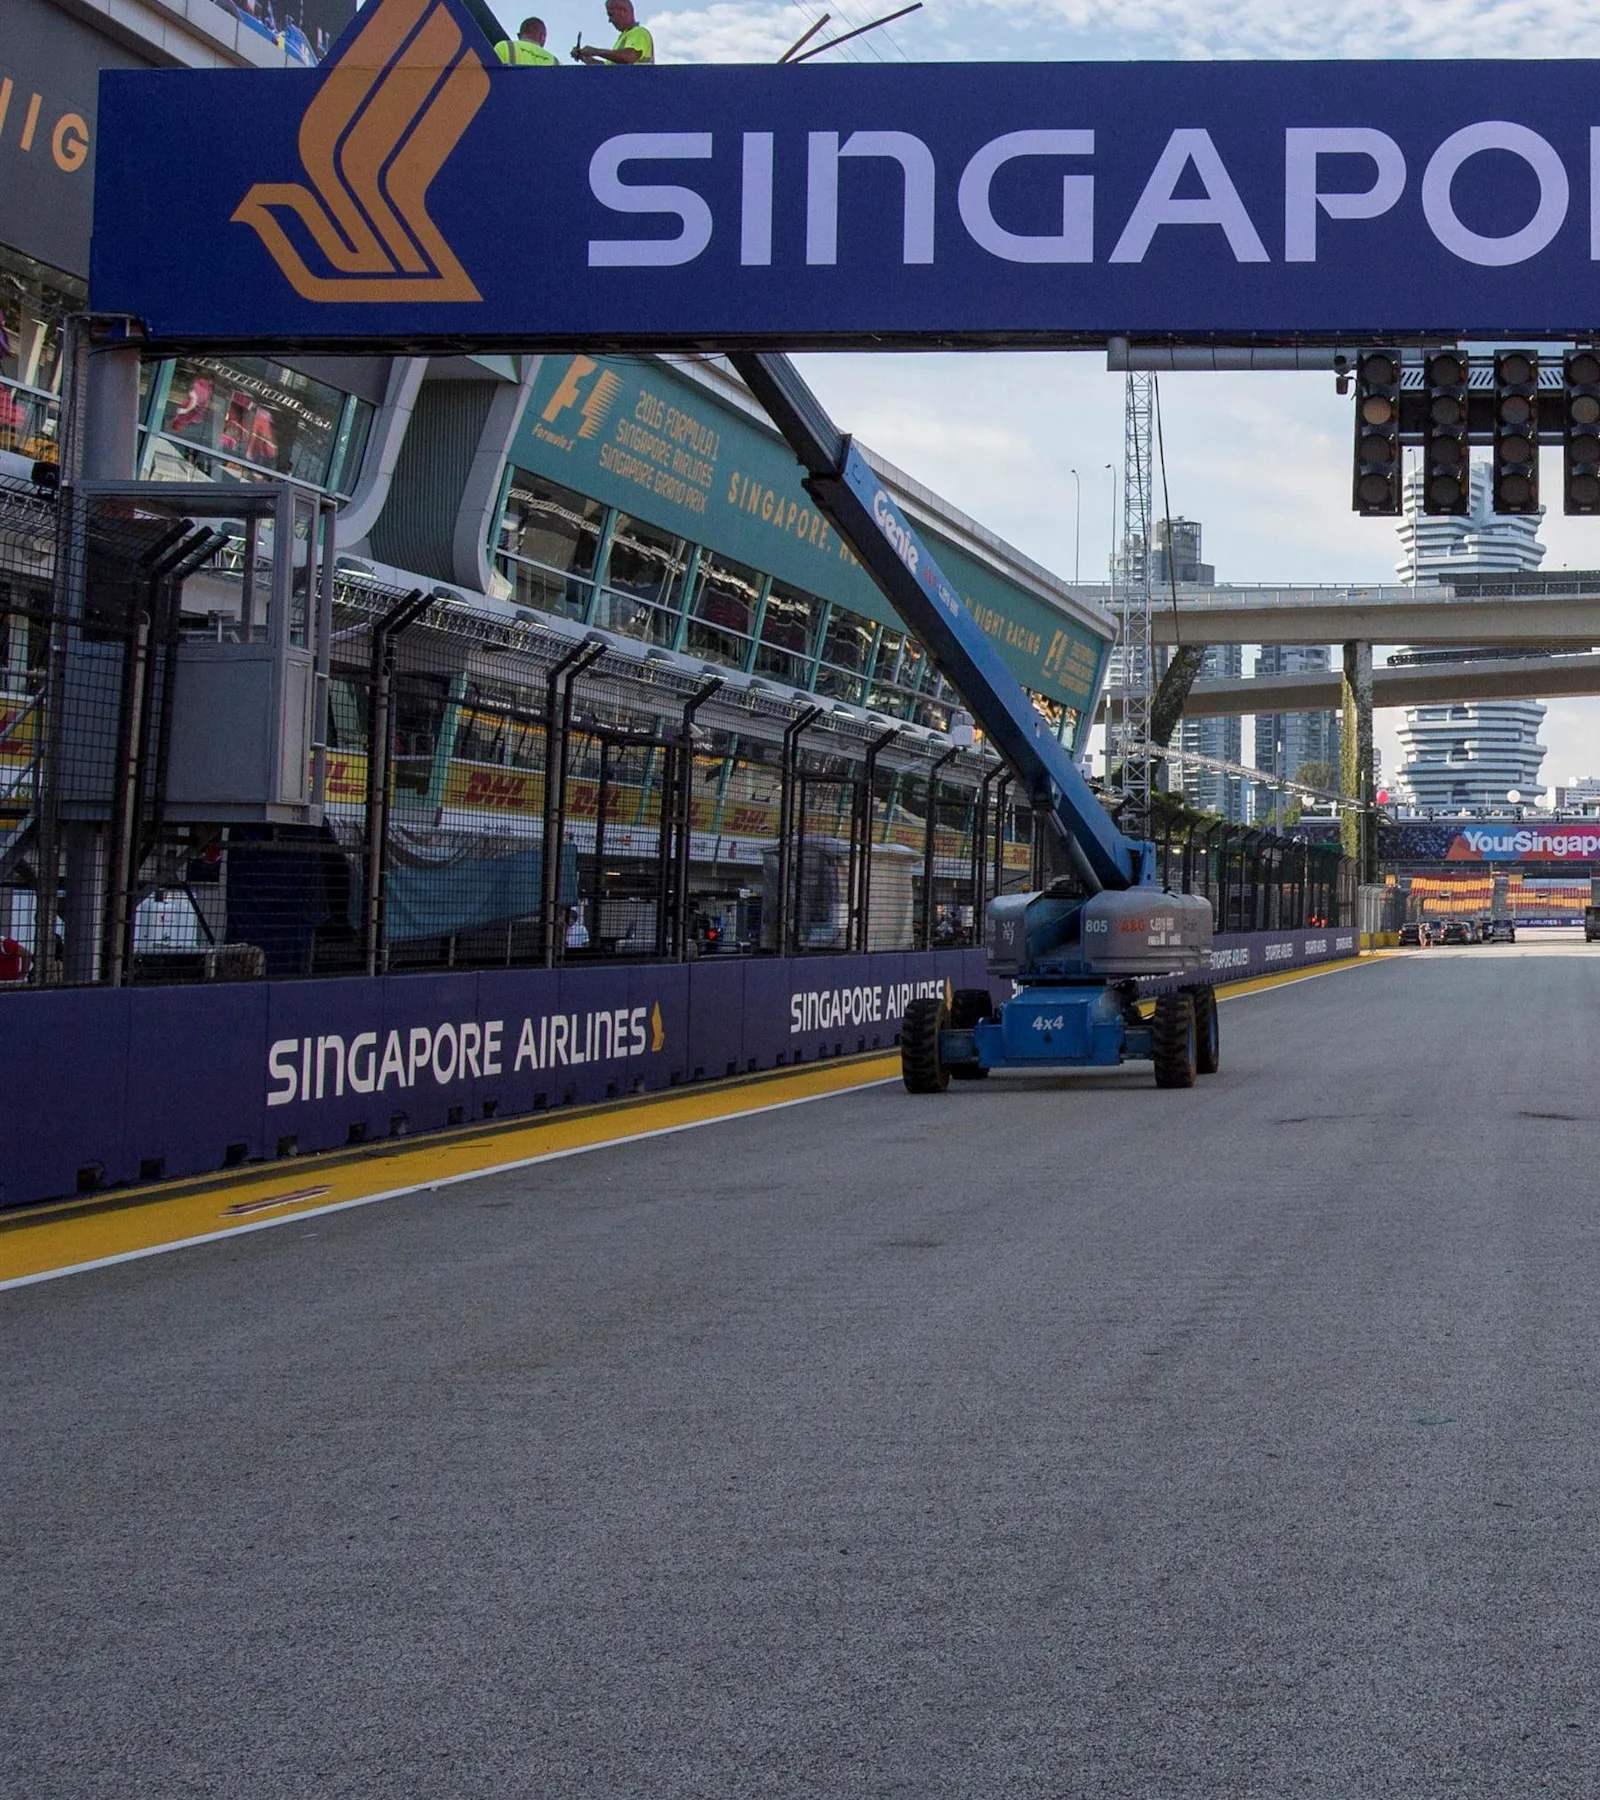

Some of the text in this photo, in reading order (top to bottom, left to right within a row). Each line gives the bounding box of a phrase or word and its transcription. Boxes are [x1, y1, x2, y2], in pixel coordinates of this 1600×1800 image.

[616, 417, 715, 488] SINGAPORE AIRLINES
[634, 390, 664, 430] 2016
[664, 407, 712, 457] FORMULA
[599, 443, 709, 514] SINGAPORE GRAND PRIX
[873, 489, 920, 575] Genie
[974, 602, 1006, 641] NIGHT
[1006, 621, 1041, 656] RACING
[1085, 919, 1108, 933] 805
[790, 986, 882, 1034] SINGAPORE
[1032, 1015, 1065, 1031] 4x4
[266, 1007, 647, 1106] SINGAPORE AIRLINES
